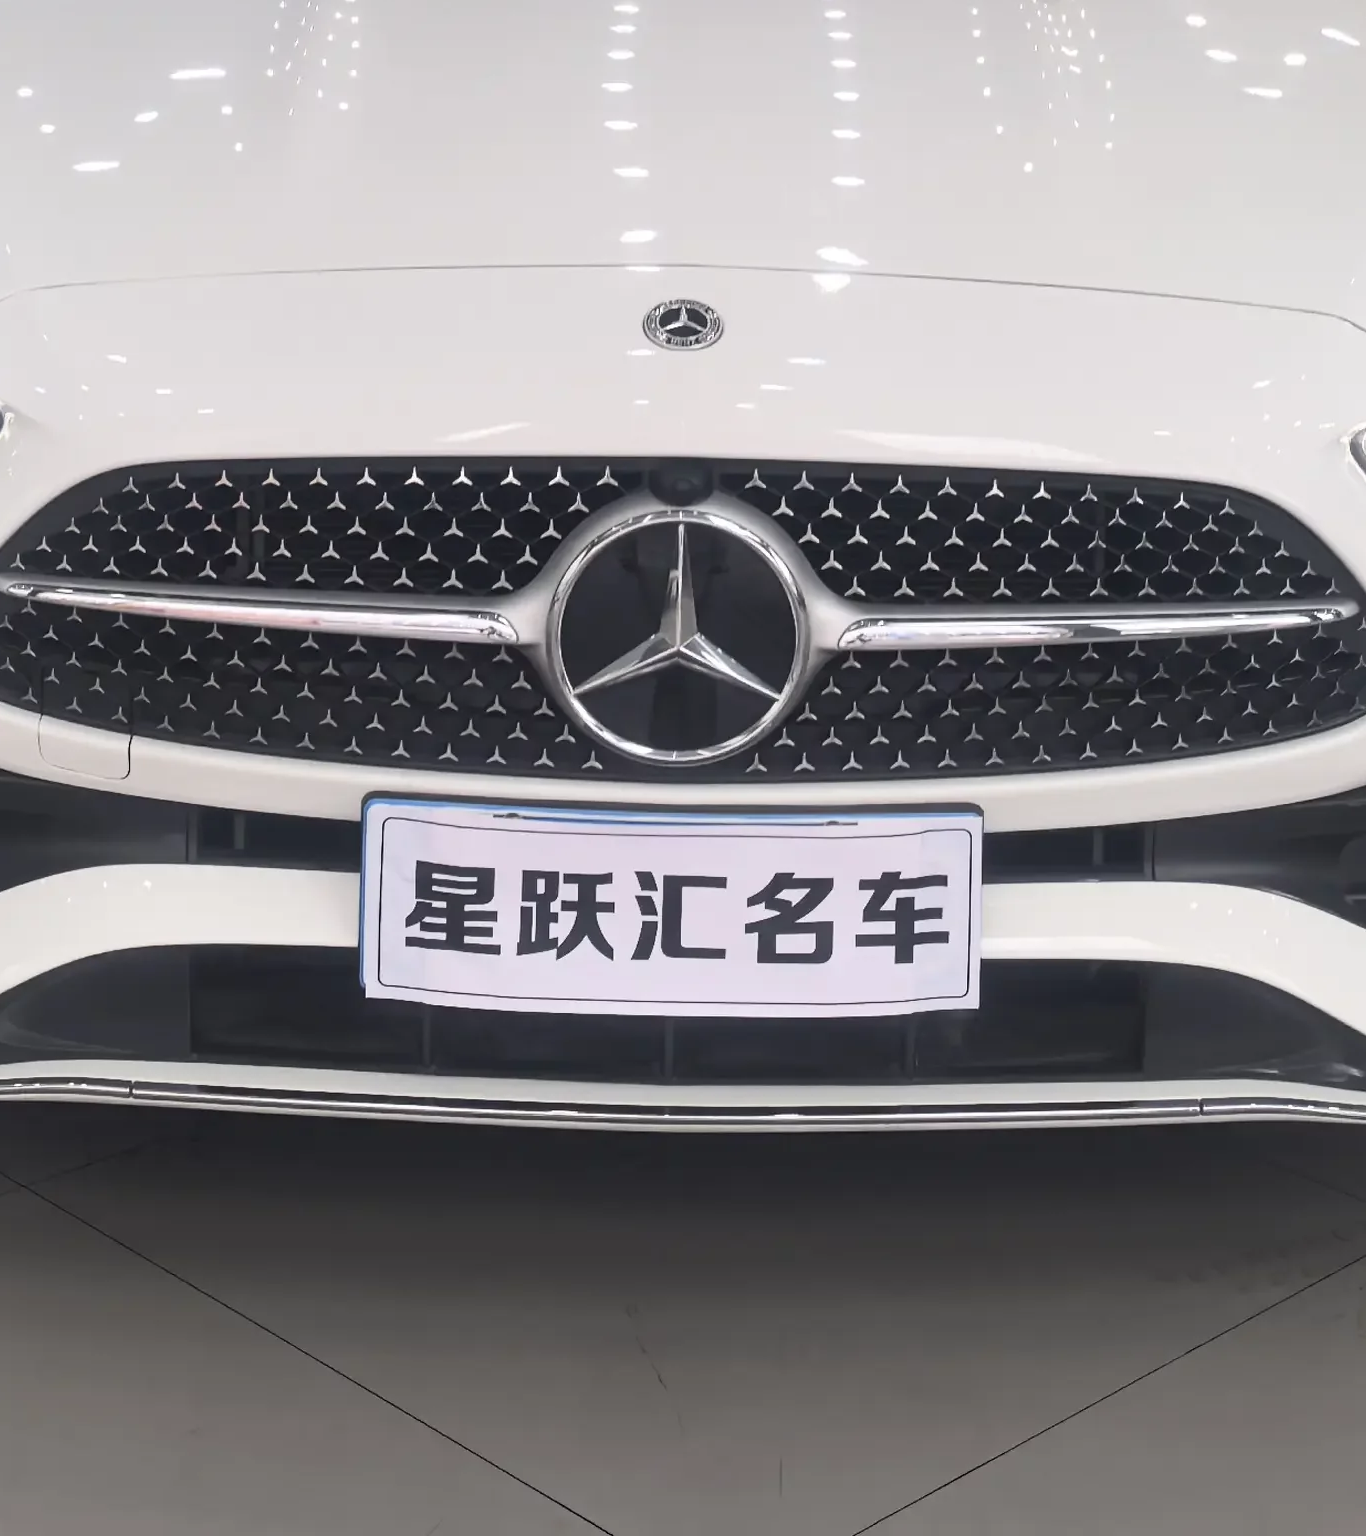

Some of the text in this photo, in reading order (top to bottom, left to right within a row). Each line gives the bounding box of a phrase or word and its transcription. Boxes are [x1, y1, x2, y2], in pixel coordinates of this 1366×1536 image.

[404, 859, 950, 965] 星跃汇名车
